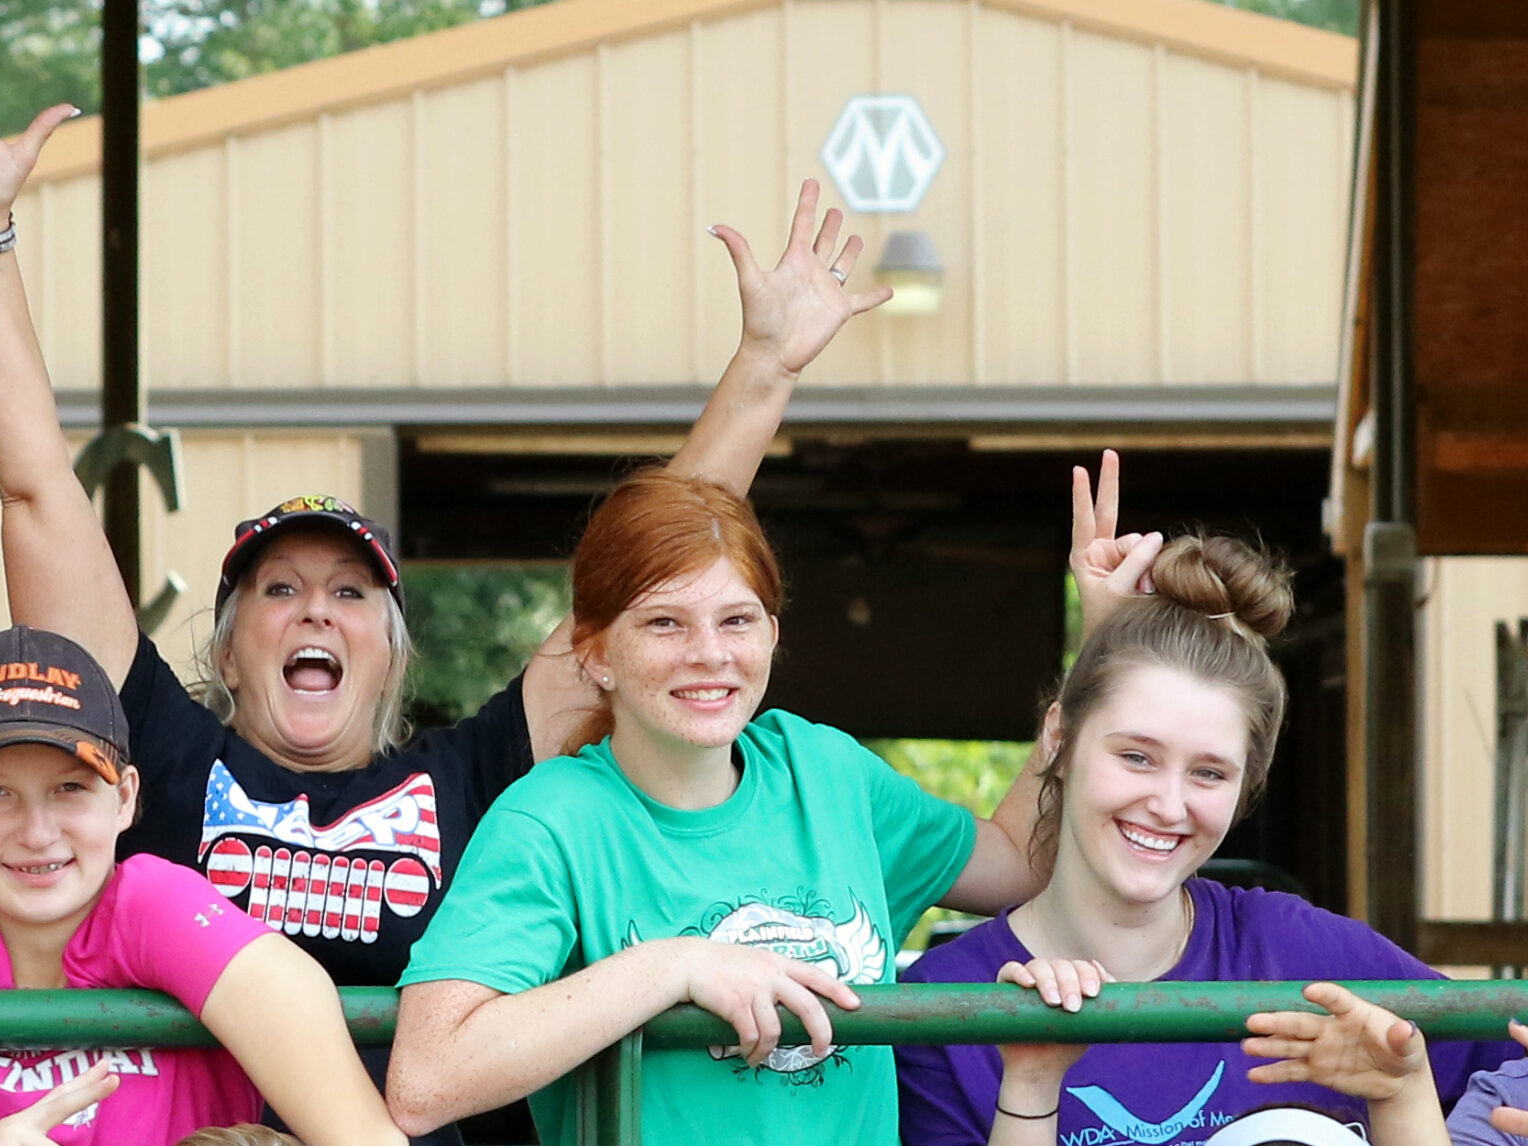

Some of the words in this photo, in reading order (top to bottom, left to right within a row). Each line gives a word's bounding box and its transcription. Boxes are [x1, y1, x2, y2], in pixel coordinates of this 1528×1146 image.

[0, 685, 81, 710] equestrian
[1126, 1121, 1184, 1139] Mission
[1187, 1109, 1206, 1129] of
